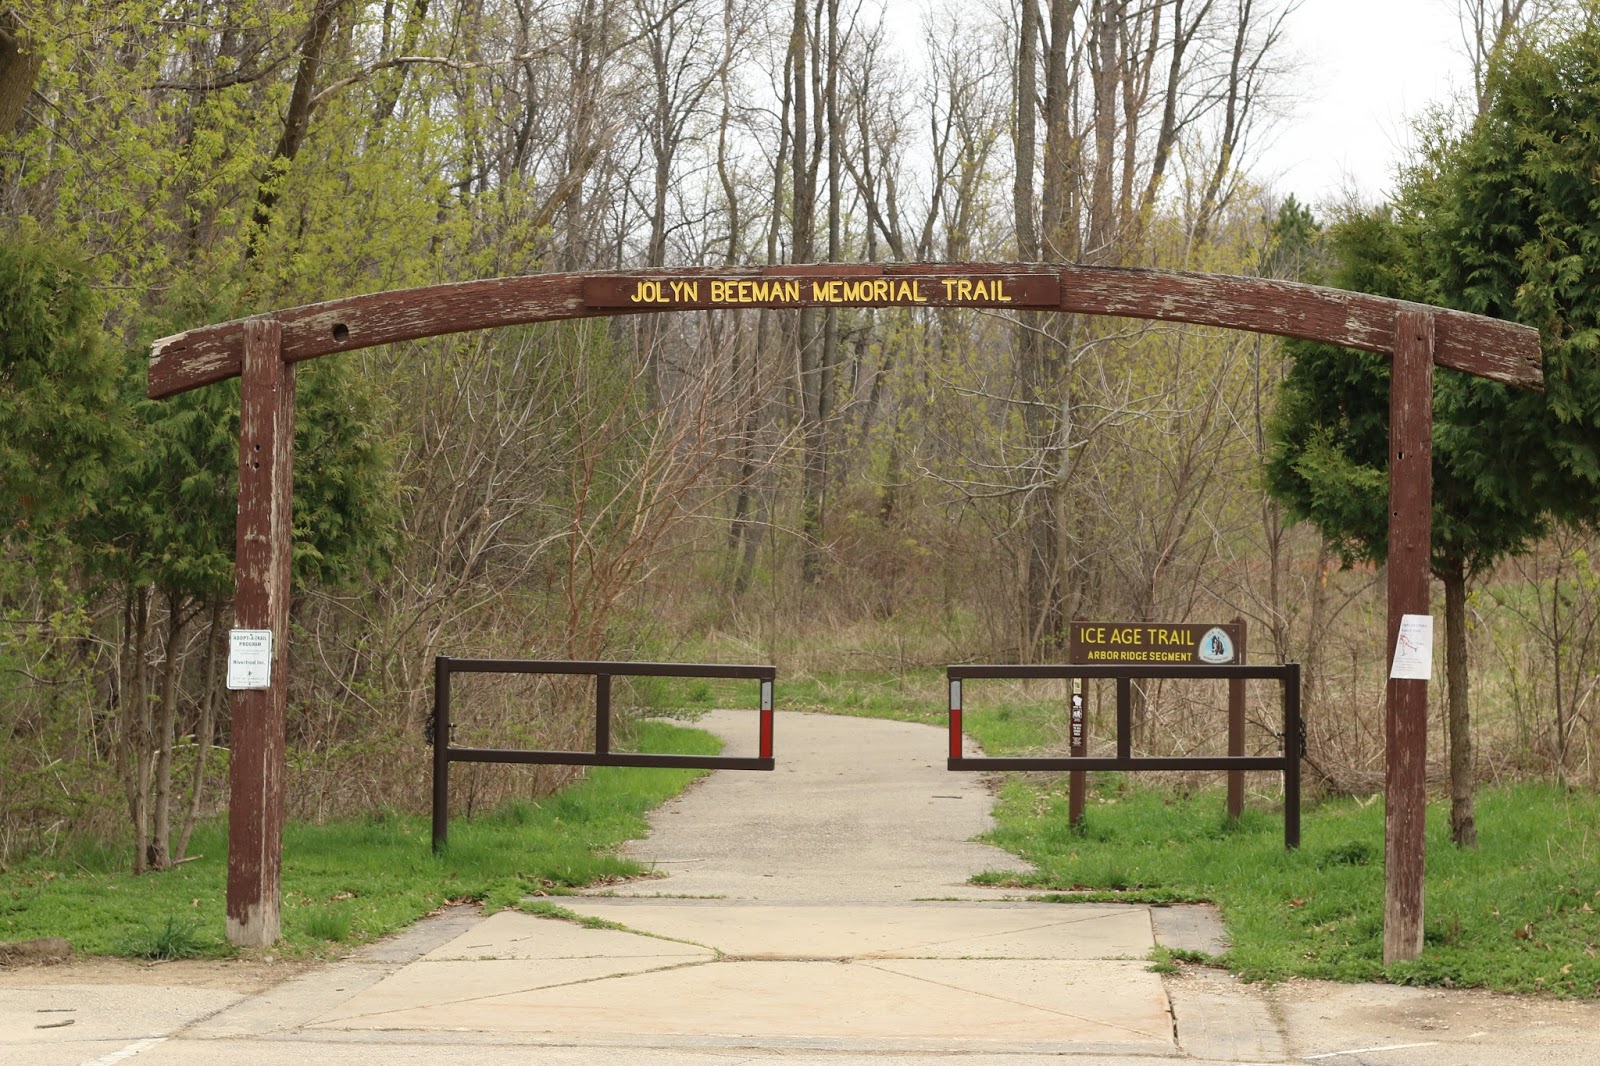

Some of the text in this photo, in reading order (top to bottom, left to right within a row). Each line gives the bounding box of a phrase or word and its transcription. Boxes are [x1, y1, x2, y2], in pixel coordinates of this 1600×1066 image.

[631, 279, 1012, 303] JOLYN BEEMAN MEMORIAL TRAIL
[1081, 627, 1195, 646] ICE AGE TRAIL
[1088, 650, 1119, 660] ARBOR
[1120, 651, 1148, 661] RIDGE
[1149, 651, 1193, 662] SEGMENT
